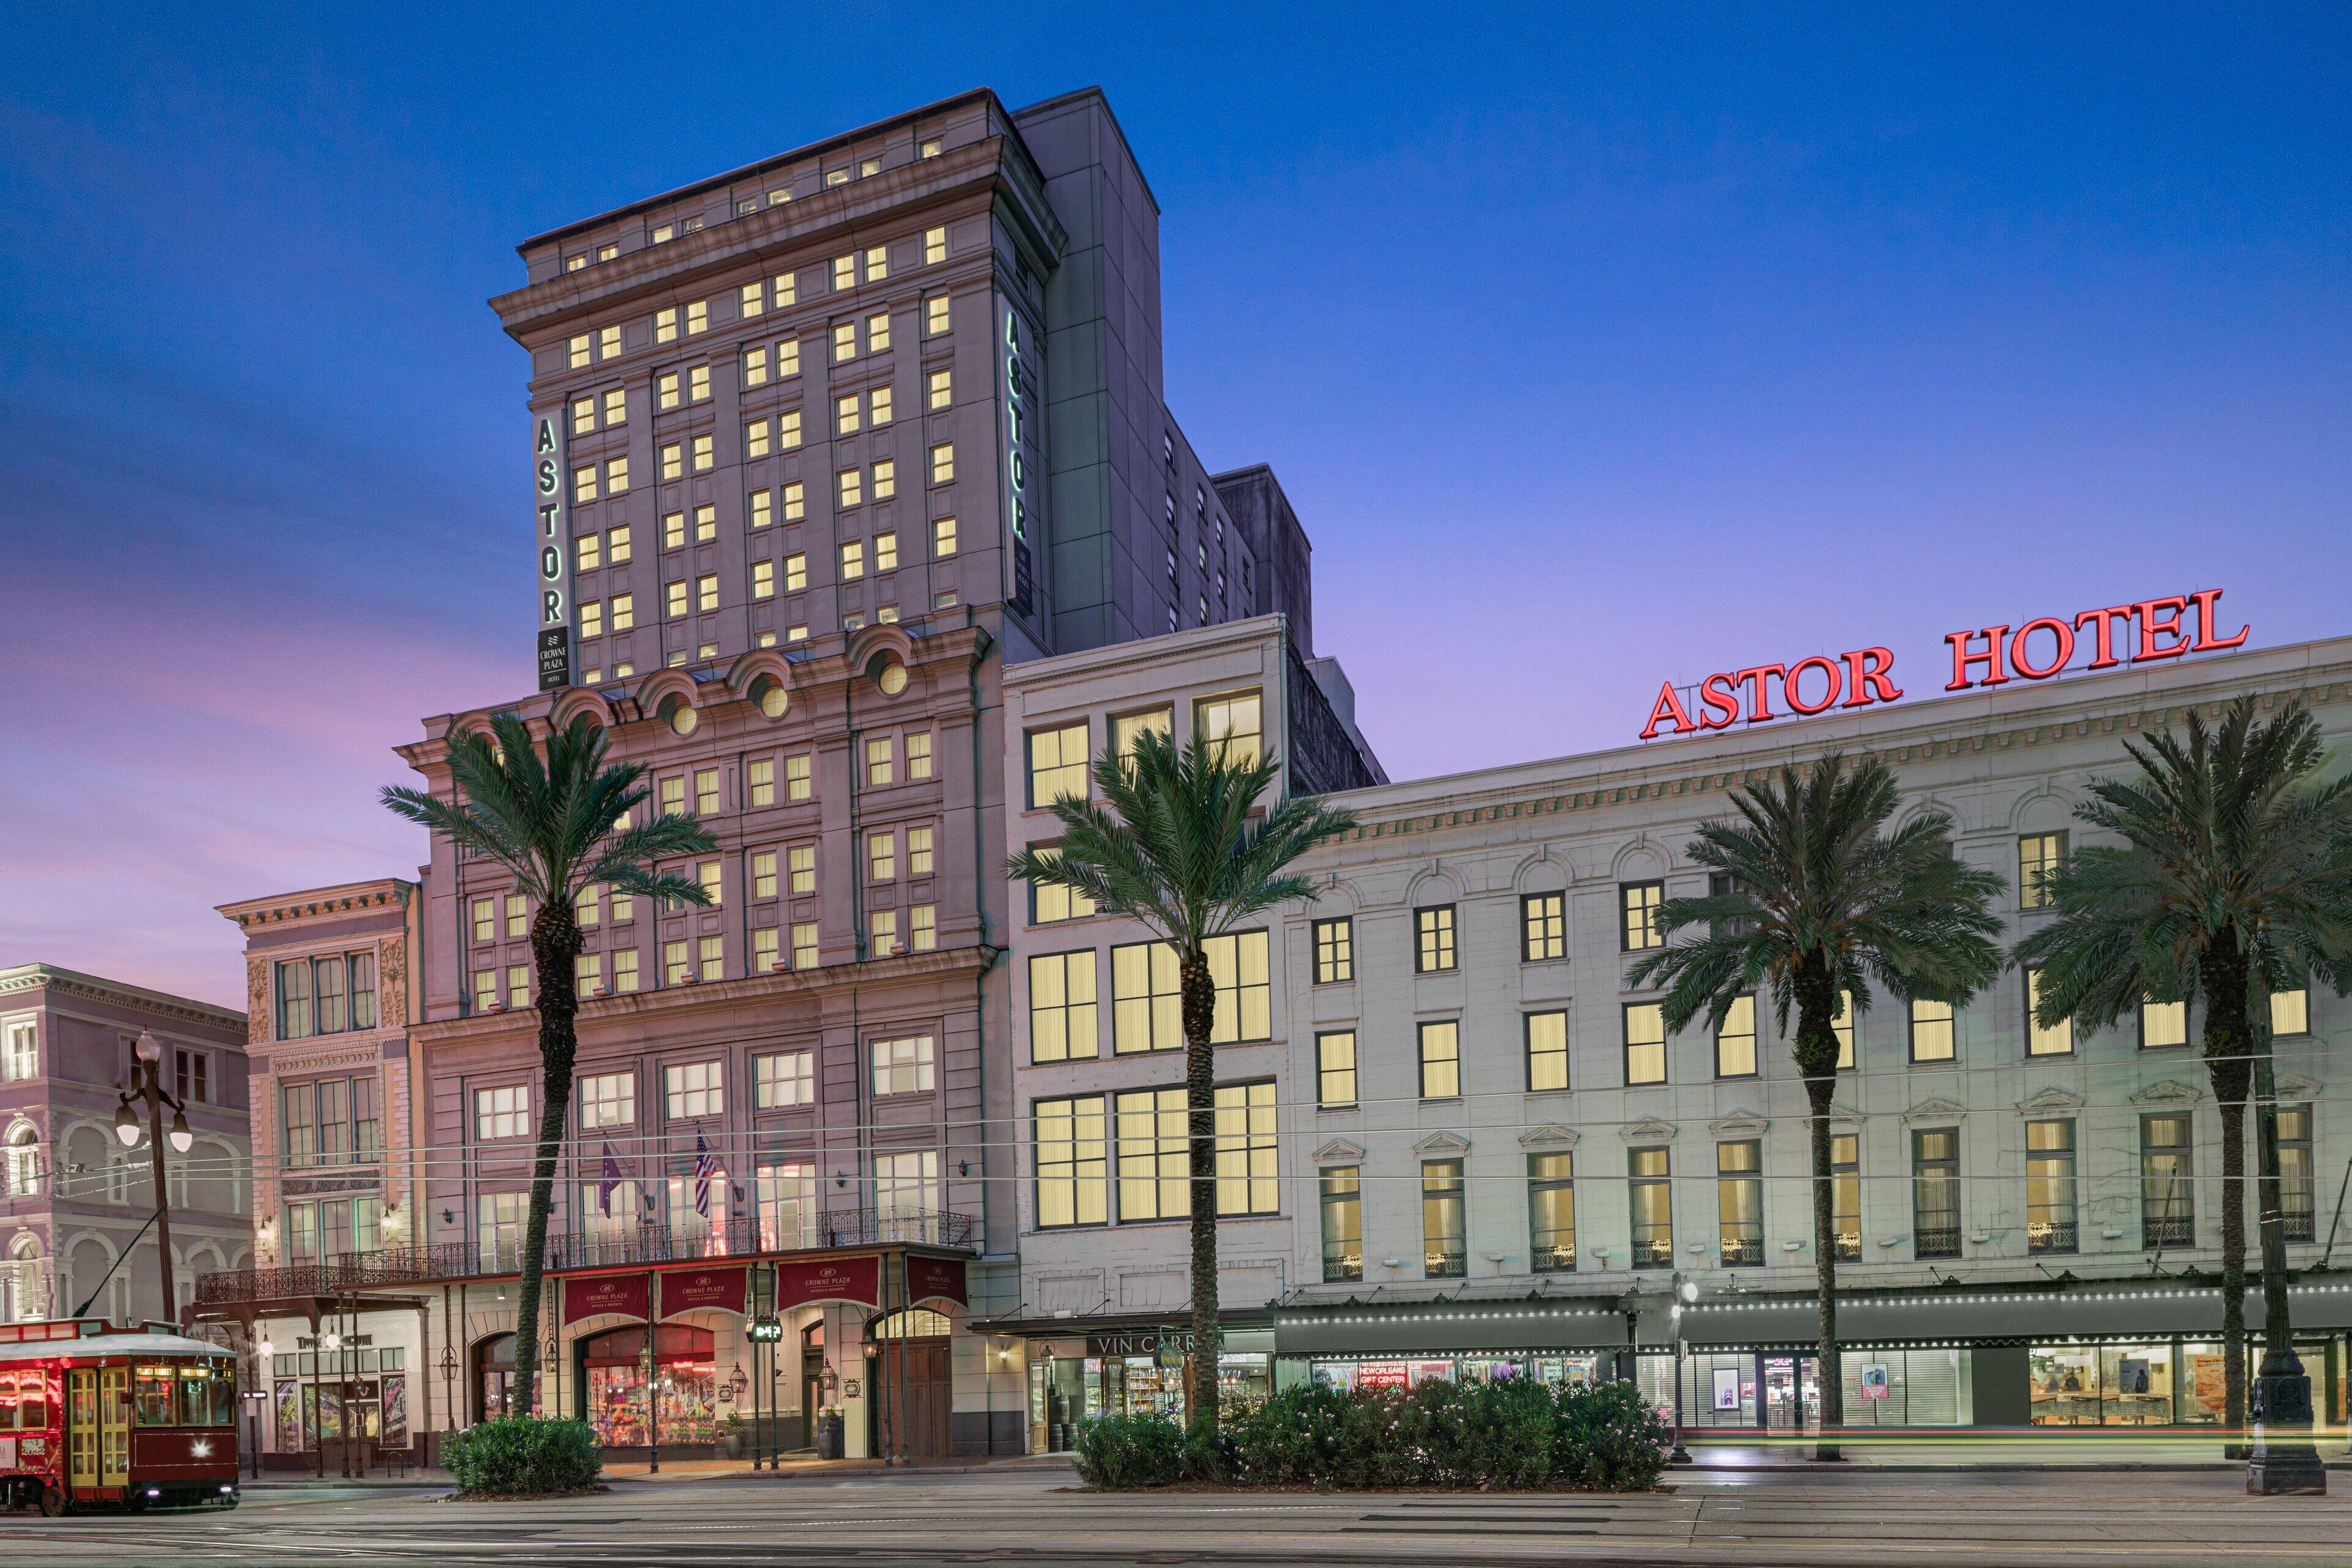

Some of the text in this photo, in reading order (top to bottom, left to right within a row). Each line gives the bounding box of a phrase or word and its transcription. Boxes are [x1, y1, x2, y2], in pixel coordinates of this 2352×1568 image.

[1007, 312, 1025, 539] ASTOR
[538, 419, 560, 623] ASTOR
[540, 647, 566, 660] CROWNE
[544, 658, 563, 670] PLAZA
[1639, 588, 2249, 740] ASTOR HOTEL
[1098, 1337, 1133, 1354] VIN
[1375, 1366, 1406, 1375] ORLEANS
[21, 1447, 45, 1456] 2022
